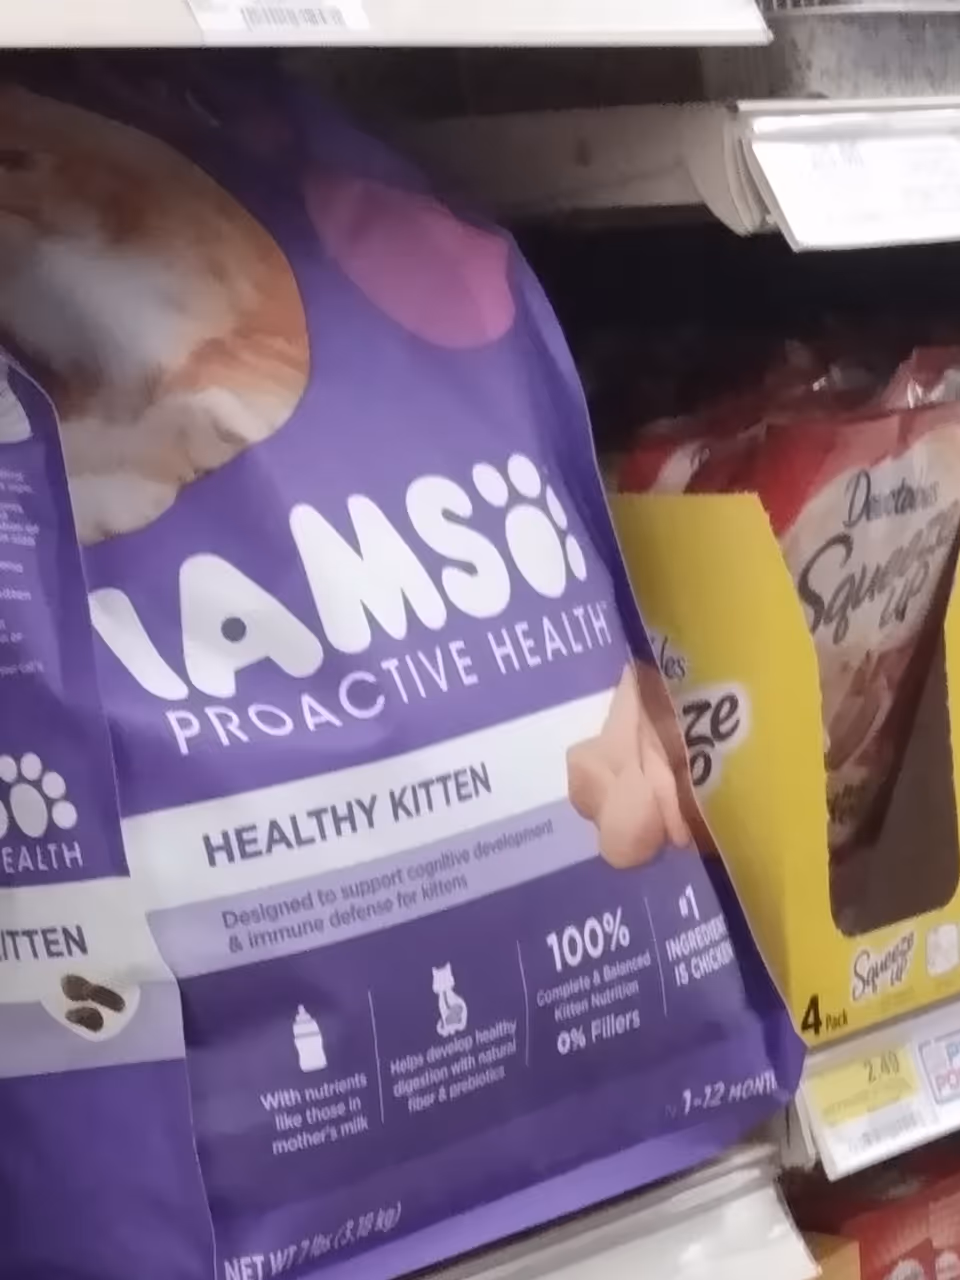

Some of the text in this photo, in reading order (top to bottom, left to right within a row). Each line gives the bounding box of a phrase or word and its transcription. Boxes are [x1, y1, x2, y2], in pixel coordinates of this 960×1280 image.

[89, 475, 512, 701] IAMS
[165, 639, 479, 756] PROACTIVE
[487, 602, 613, 676] HEALTH
[202, 761, 492, 867] HEALTHY KITTEN
[222, 819, 554, 930] Designed to support cognitive development
[228, 874, 469, 954] & immune defense for kittens
[546, 905, 630, 973] 100%
[536, 975, 591, 1007] Complete
[603, 949, 651, 982] Balanced
[674, 962, 689, 987] IS
[554, 980, 640, 1022] Kitten Nutrition
[801, 995, 848, 1036] 4 Pack
[557, 1008, 641, 1055] 0% Fillers
[260, 1072, 368, 1111] With nutrients
[683, 1080, 726, 1116] 1-12
[272, 1114, 369, 1155] mother's milk
[275, 1097, 362, 1132] like those in
[269, 1245, 298, 1276] WT
